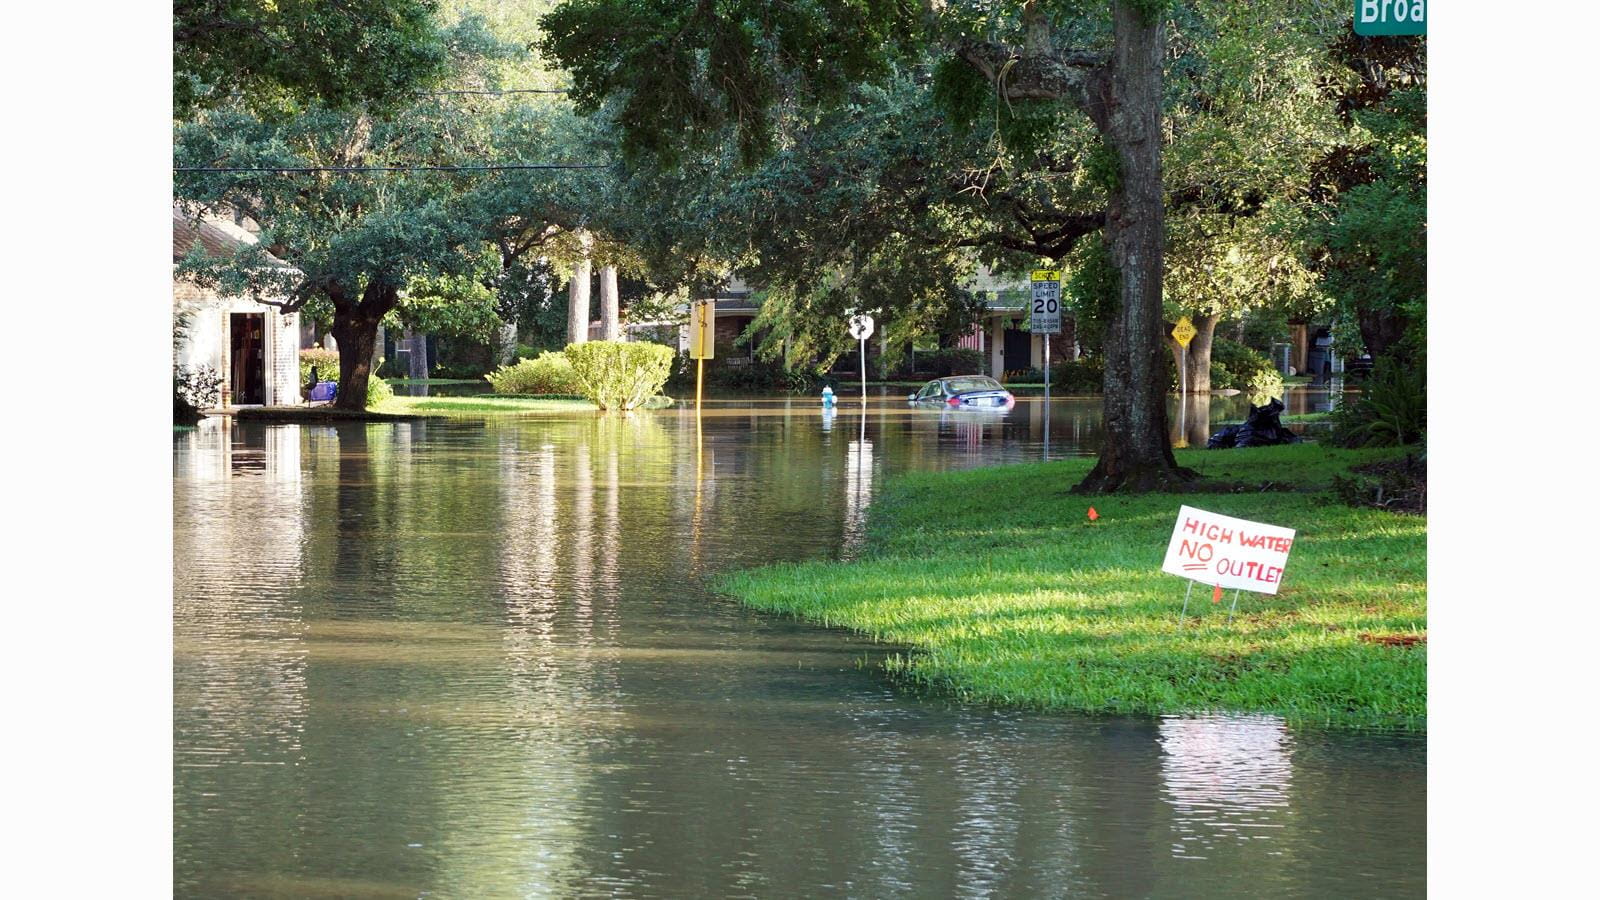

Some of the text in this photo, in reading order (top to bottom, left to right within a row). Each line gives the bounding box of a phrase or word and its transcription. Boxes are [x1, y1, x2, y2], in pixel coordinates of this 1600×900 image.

[1361, 0, 1424, 22] Broa
[1034, 299, 1057, 313] 20
[1183, 517, 1294, 553] HIGH WATER
[1179, 539, 1283, 583] NO OUTLET
